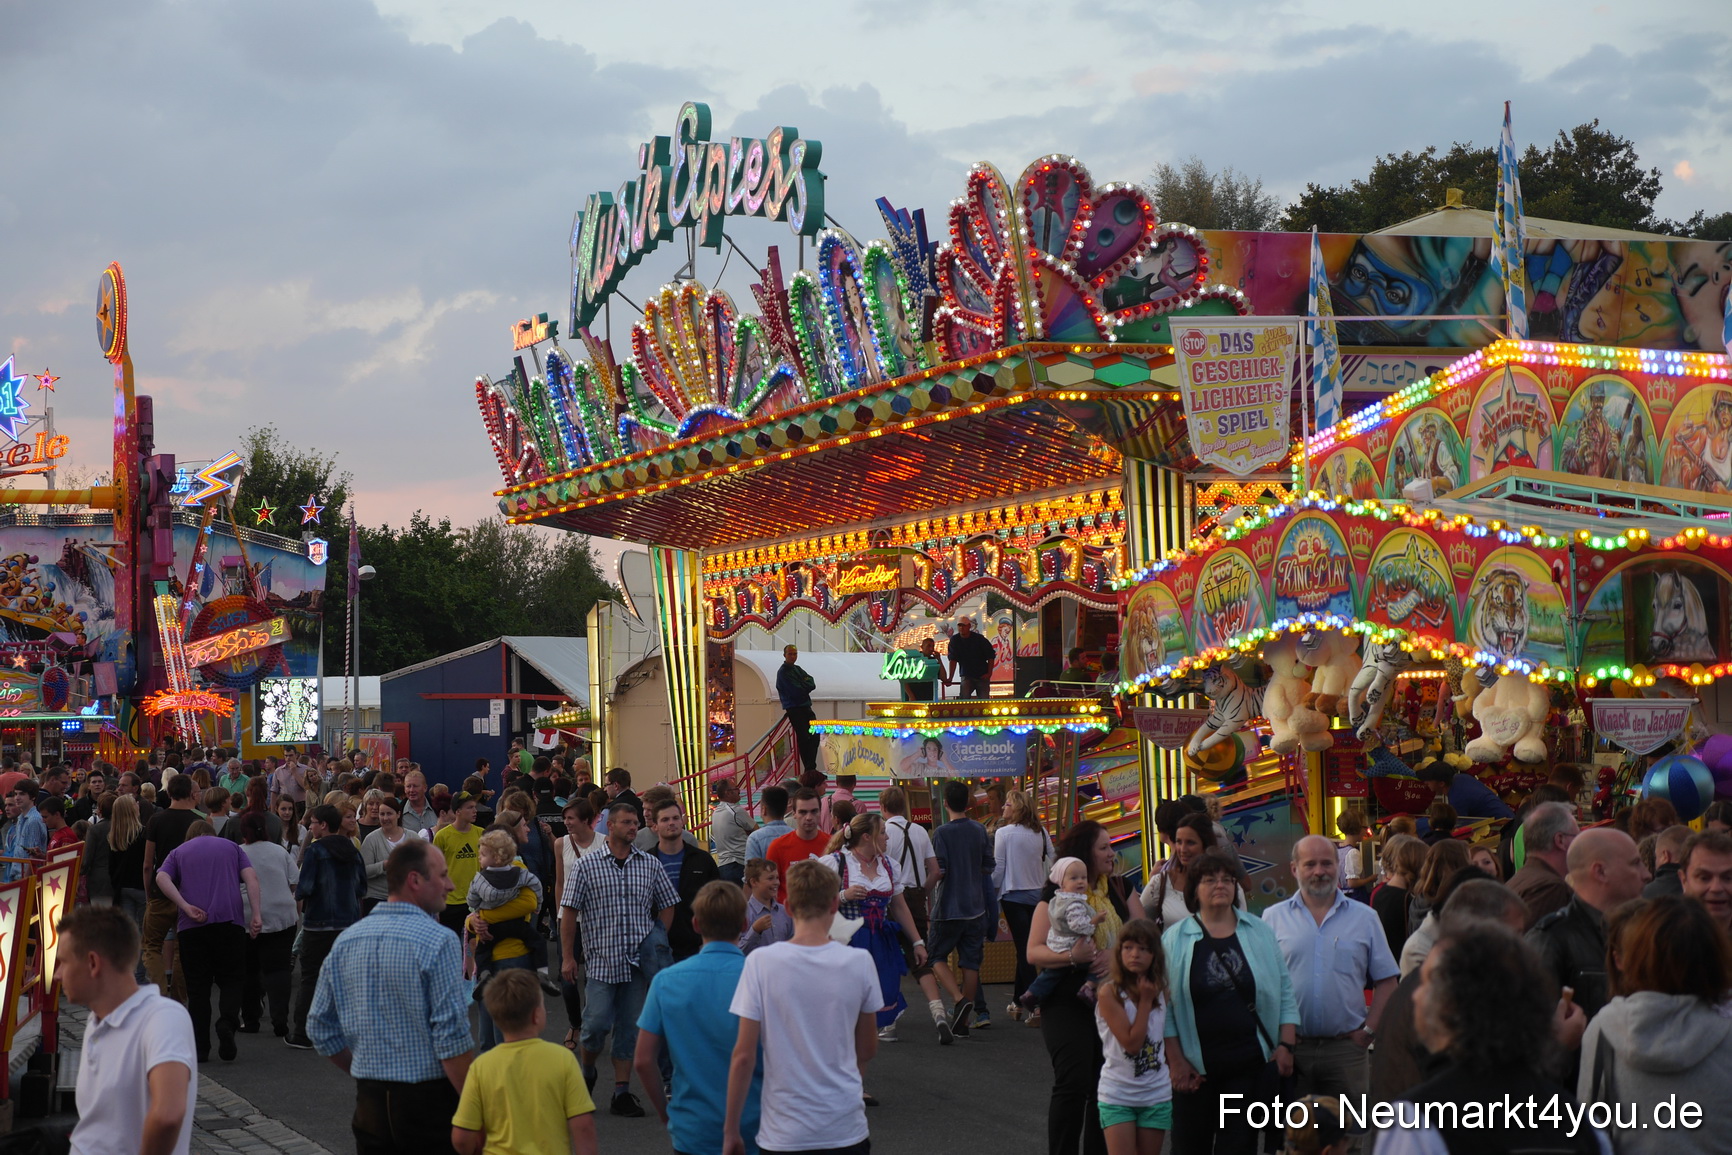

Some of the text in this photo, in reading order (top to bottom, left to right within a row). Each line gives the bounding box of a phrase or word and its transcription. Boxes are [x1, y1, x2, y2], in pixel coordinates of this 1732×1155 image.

[569, 101, 815, 339] Musik Express
[1184, 337, 1205, 351] STOP
[1220, 332, 1254, 354] DAS
[1259, 334, 1293, 356] GEWINNE!
[1263, 326, 1287, 342] SUPER
[1192, 357, 1285, 385] GESCHICK-
[1190, 382, 1289, 413] LICHKEITS-
[1218, 410, 1269, 437] SPIEL
[1478, 389, 1548, 453] WINNER
[0, 430, 71, 468] ele
[1278, 553, 1346, 592] KING PLAY
[1202, 570, 1250, 617] ULTRA
[1387, 593, 1418, 621] Super
[207, 610, 250, 635] SPLASH
[1216, 600, 1248, 644] Play
[880, 650, 926, 681] Kasse
[157, 694, 220, 710] SPLASH
[1598, 707, 1687, 735] Knack den Jackpot
[956, 740, 1016, 755] facebook
